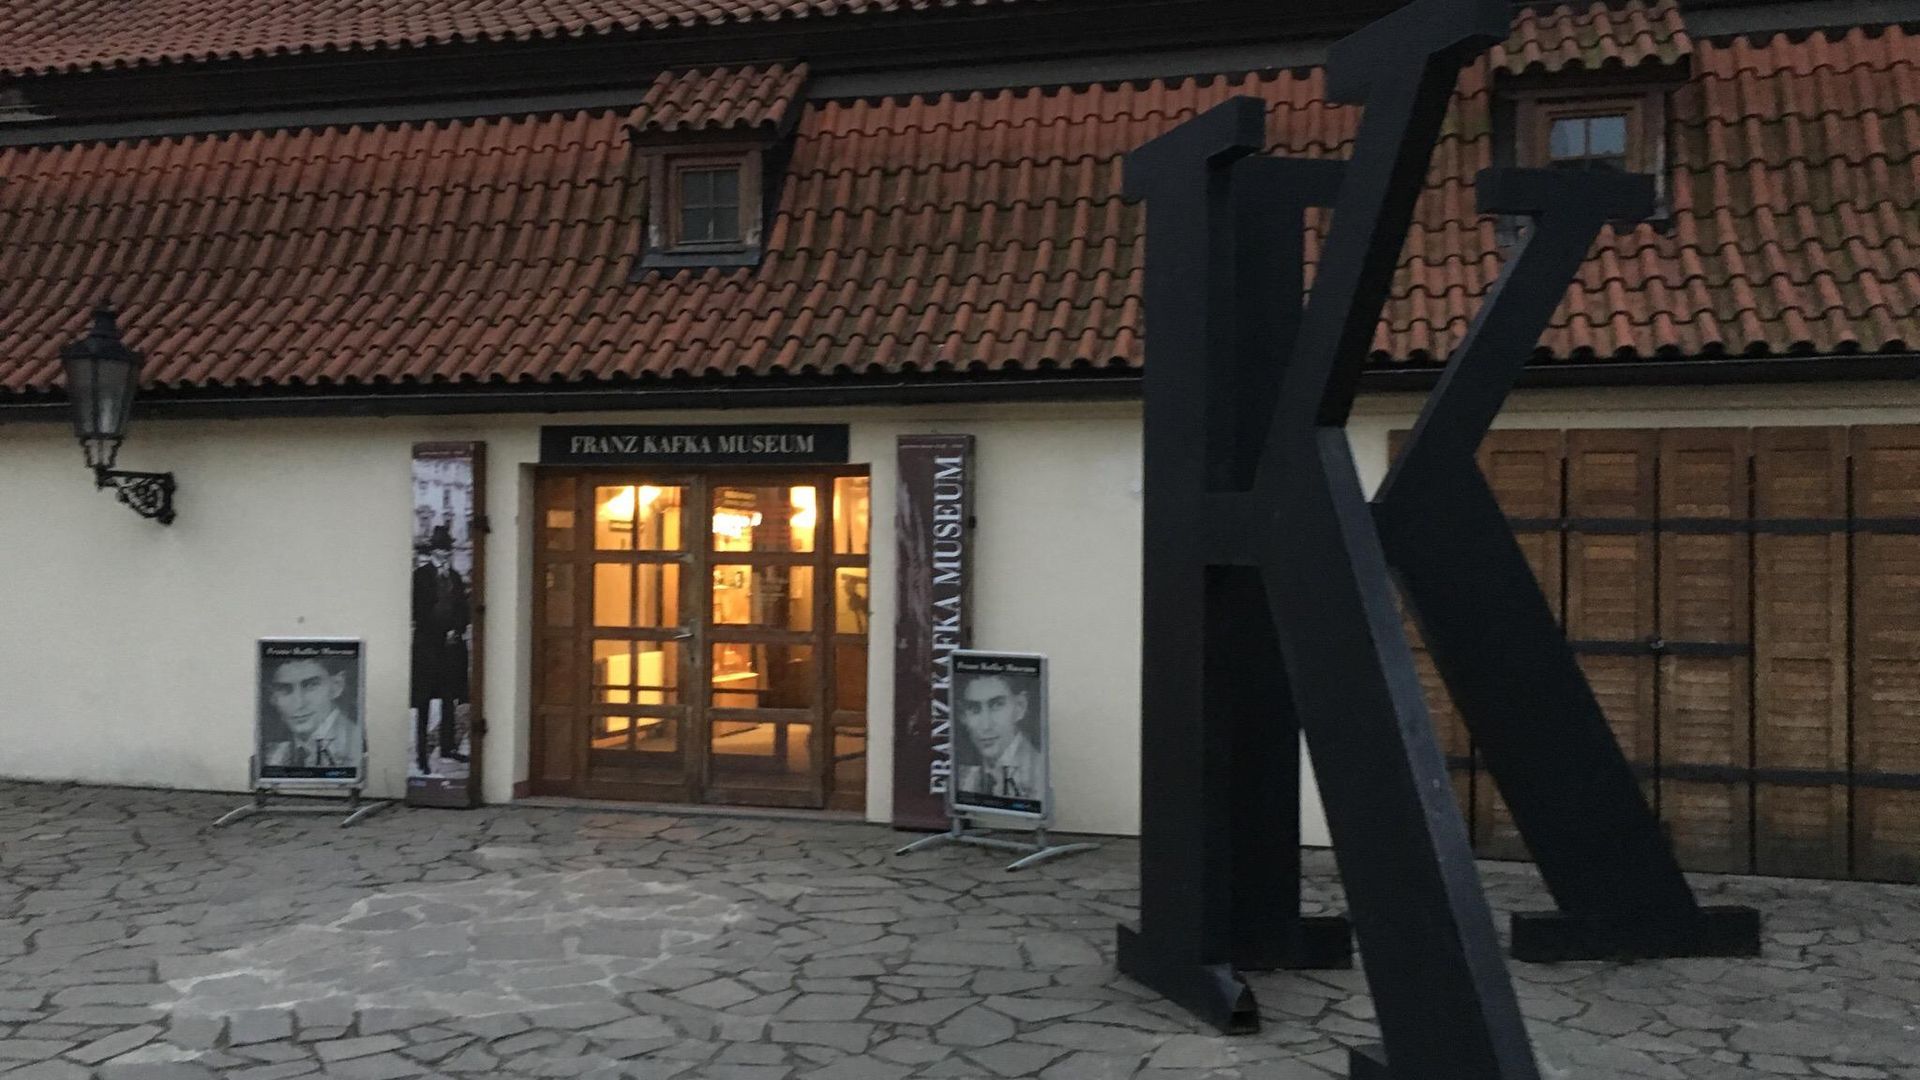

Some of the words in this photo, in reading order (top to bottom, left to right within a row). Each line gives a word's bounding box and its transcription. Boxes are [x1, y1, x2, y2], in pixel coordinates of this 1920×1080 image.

[570, 435, 638, 454] FRANZ
[643, 435, 711, 454] KAFKA
[717, 434, 815, 454] MUSEUM
[932, 455, 964, 586] MUSEUM
[931, 595, 962, 690] KAFKA
[315, 738, 336, 766] K
